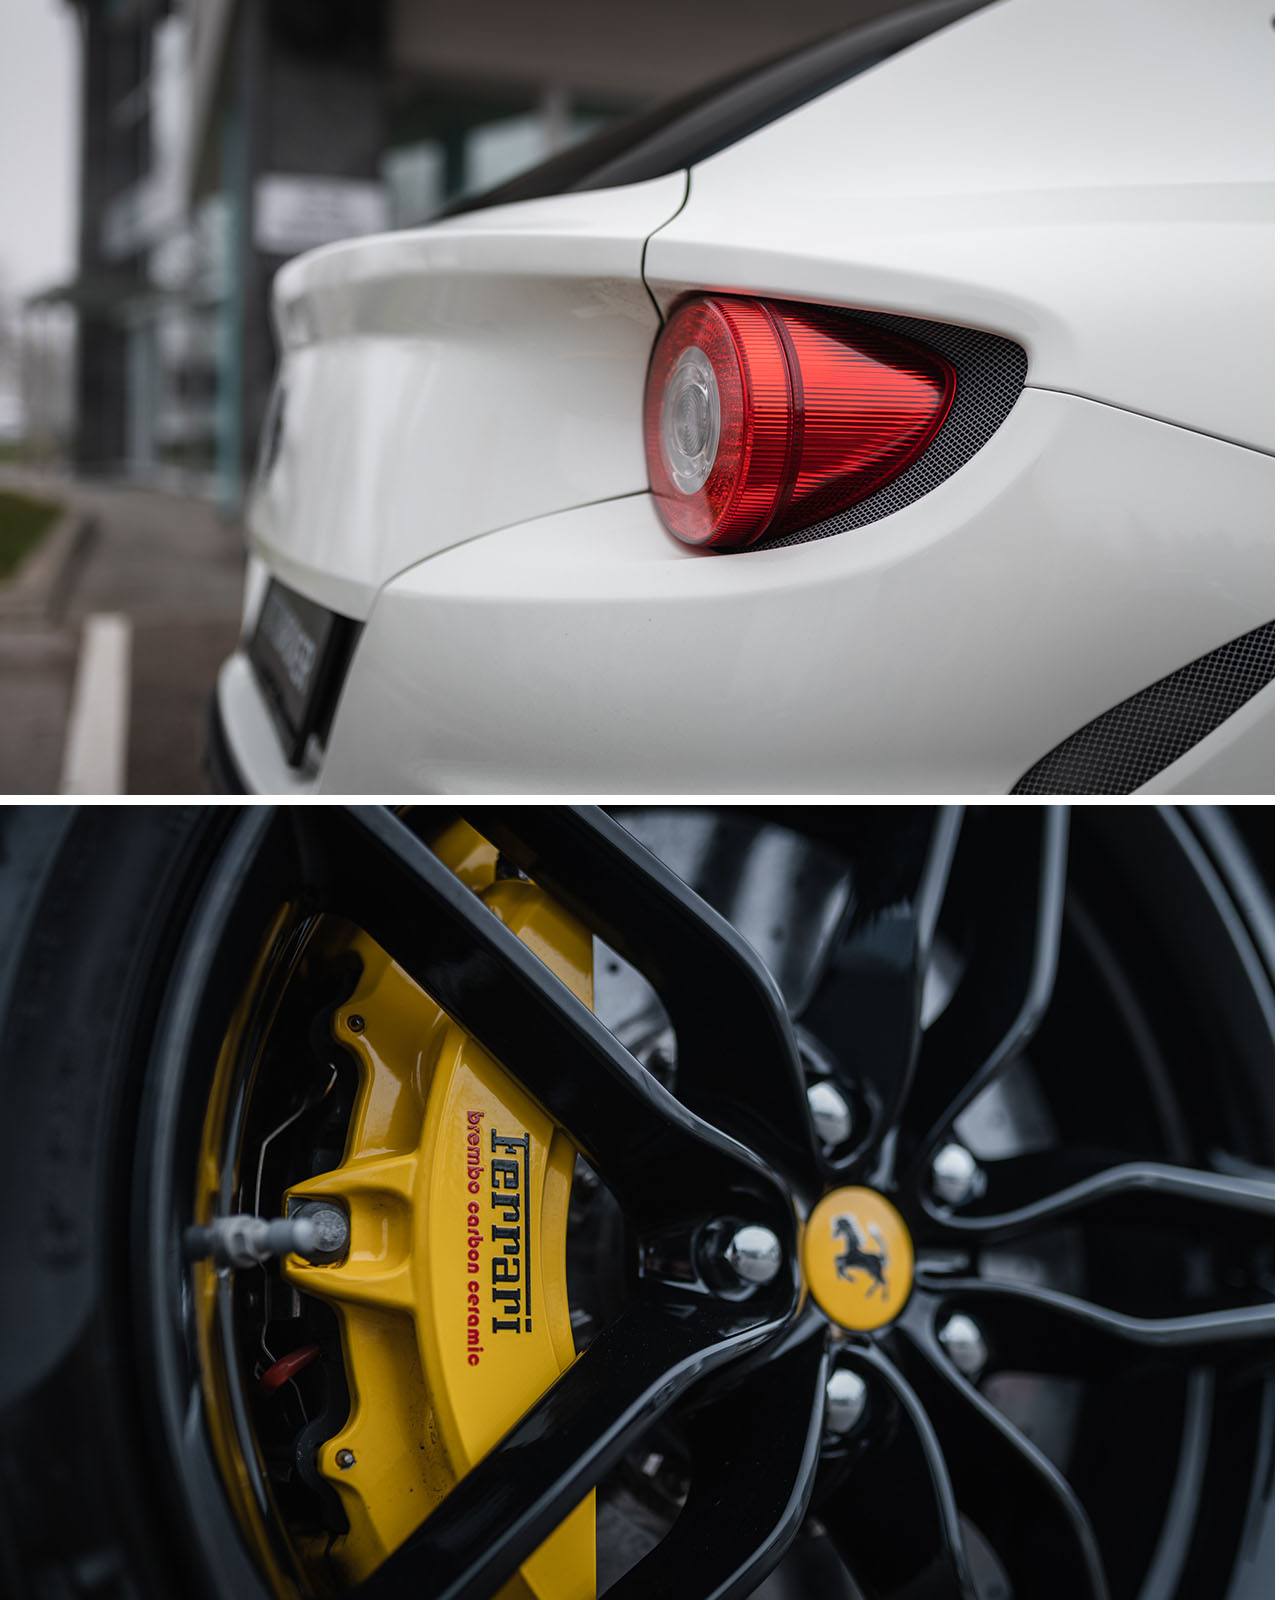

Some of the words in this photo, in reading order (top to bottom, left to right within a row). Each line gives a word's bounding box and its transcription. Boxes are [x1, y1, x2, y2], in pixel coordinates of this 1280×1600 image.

[467, 1110, 484, 1194] brembo
[467, 1200, 483, 1274] carbon
[491, 1128, 532, 1334] Ferrari
[467, 1280, 484, 1366] ceramic
